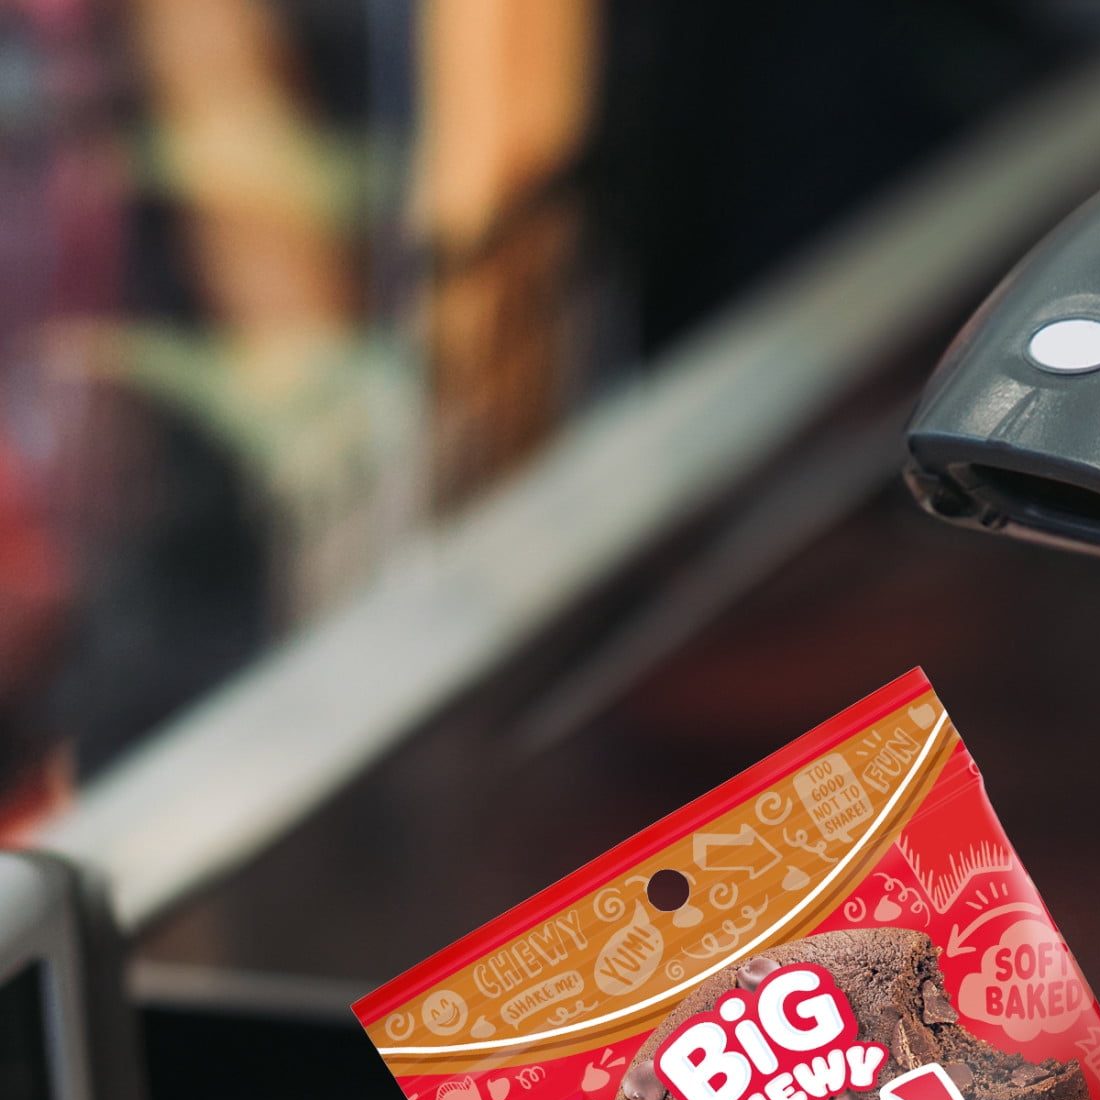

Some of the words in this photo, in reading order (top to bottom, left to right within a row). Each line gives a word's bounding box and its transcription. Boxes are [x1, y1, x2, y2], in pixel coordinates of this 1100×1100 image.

[804, 760, 832, 785] TOO
[862, 727, 921, 794] FUN
[811, 774, 845, 801] GOOD
[812, 795, 841, 821] NOT
[840, 784, 860, 803] TO
[824, 800, 868, 834] SHARE!
[473, 909, 588, 998] CHEWY
[600, 925, 660, 987] YUM!
[994, 942, 1069, 982] SOFT
[506, 987, 552, 1020] SHARE
[554, 973, 580, 996] ME!
[985, 979, 1084, 1020] BAKED
